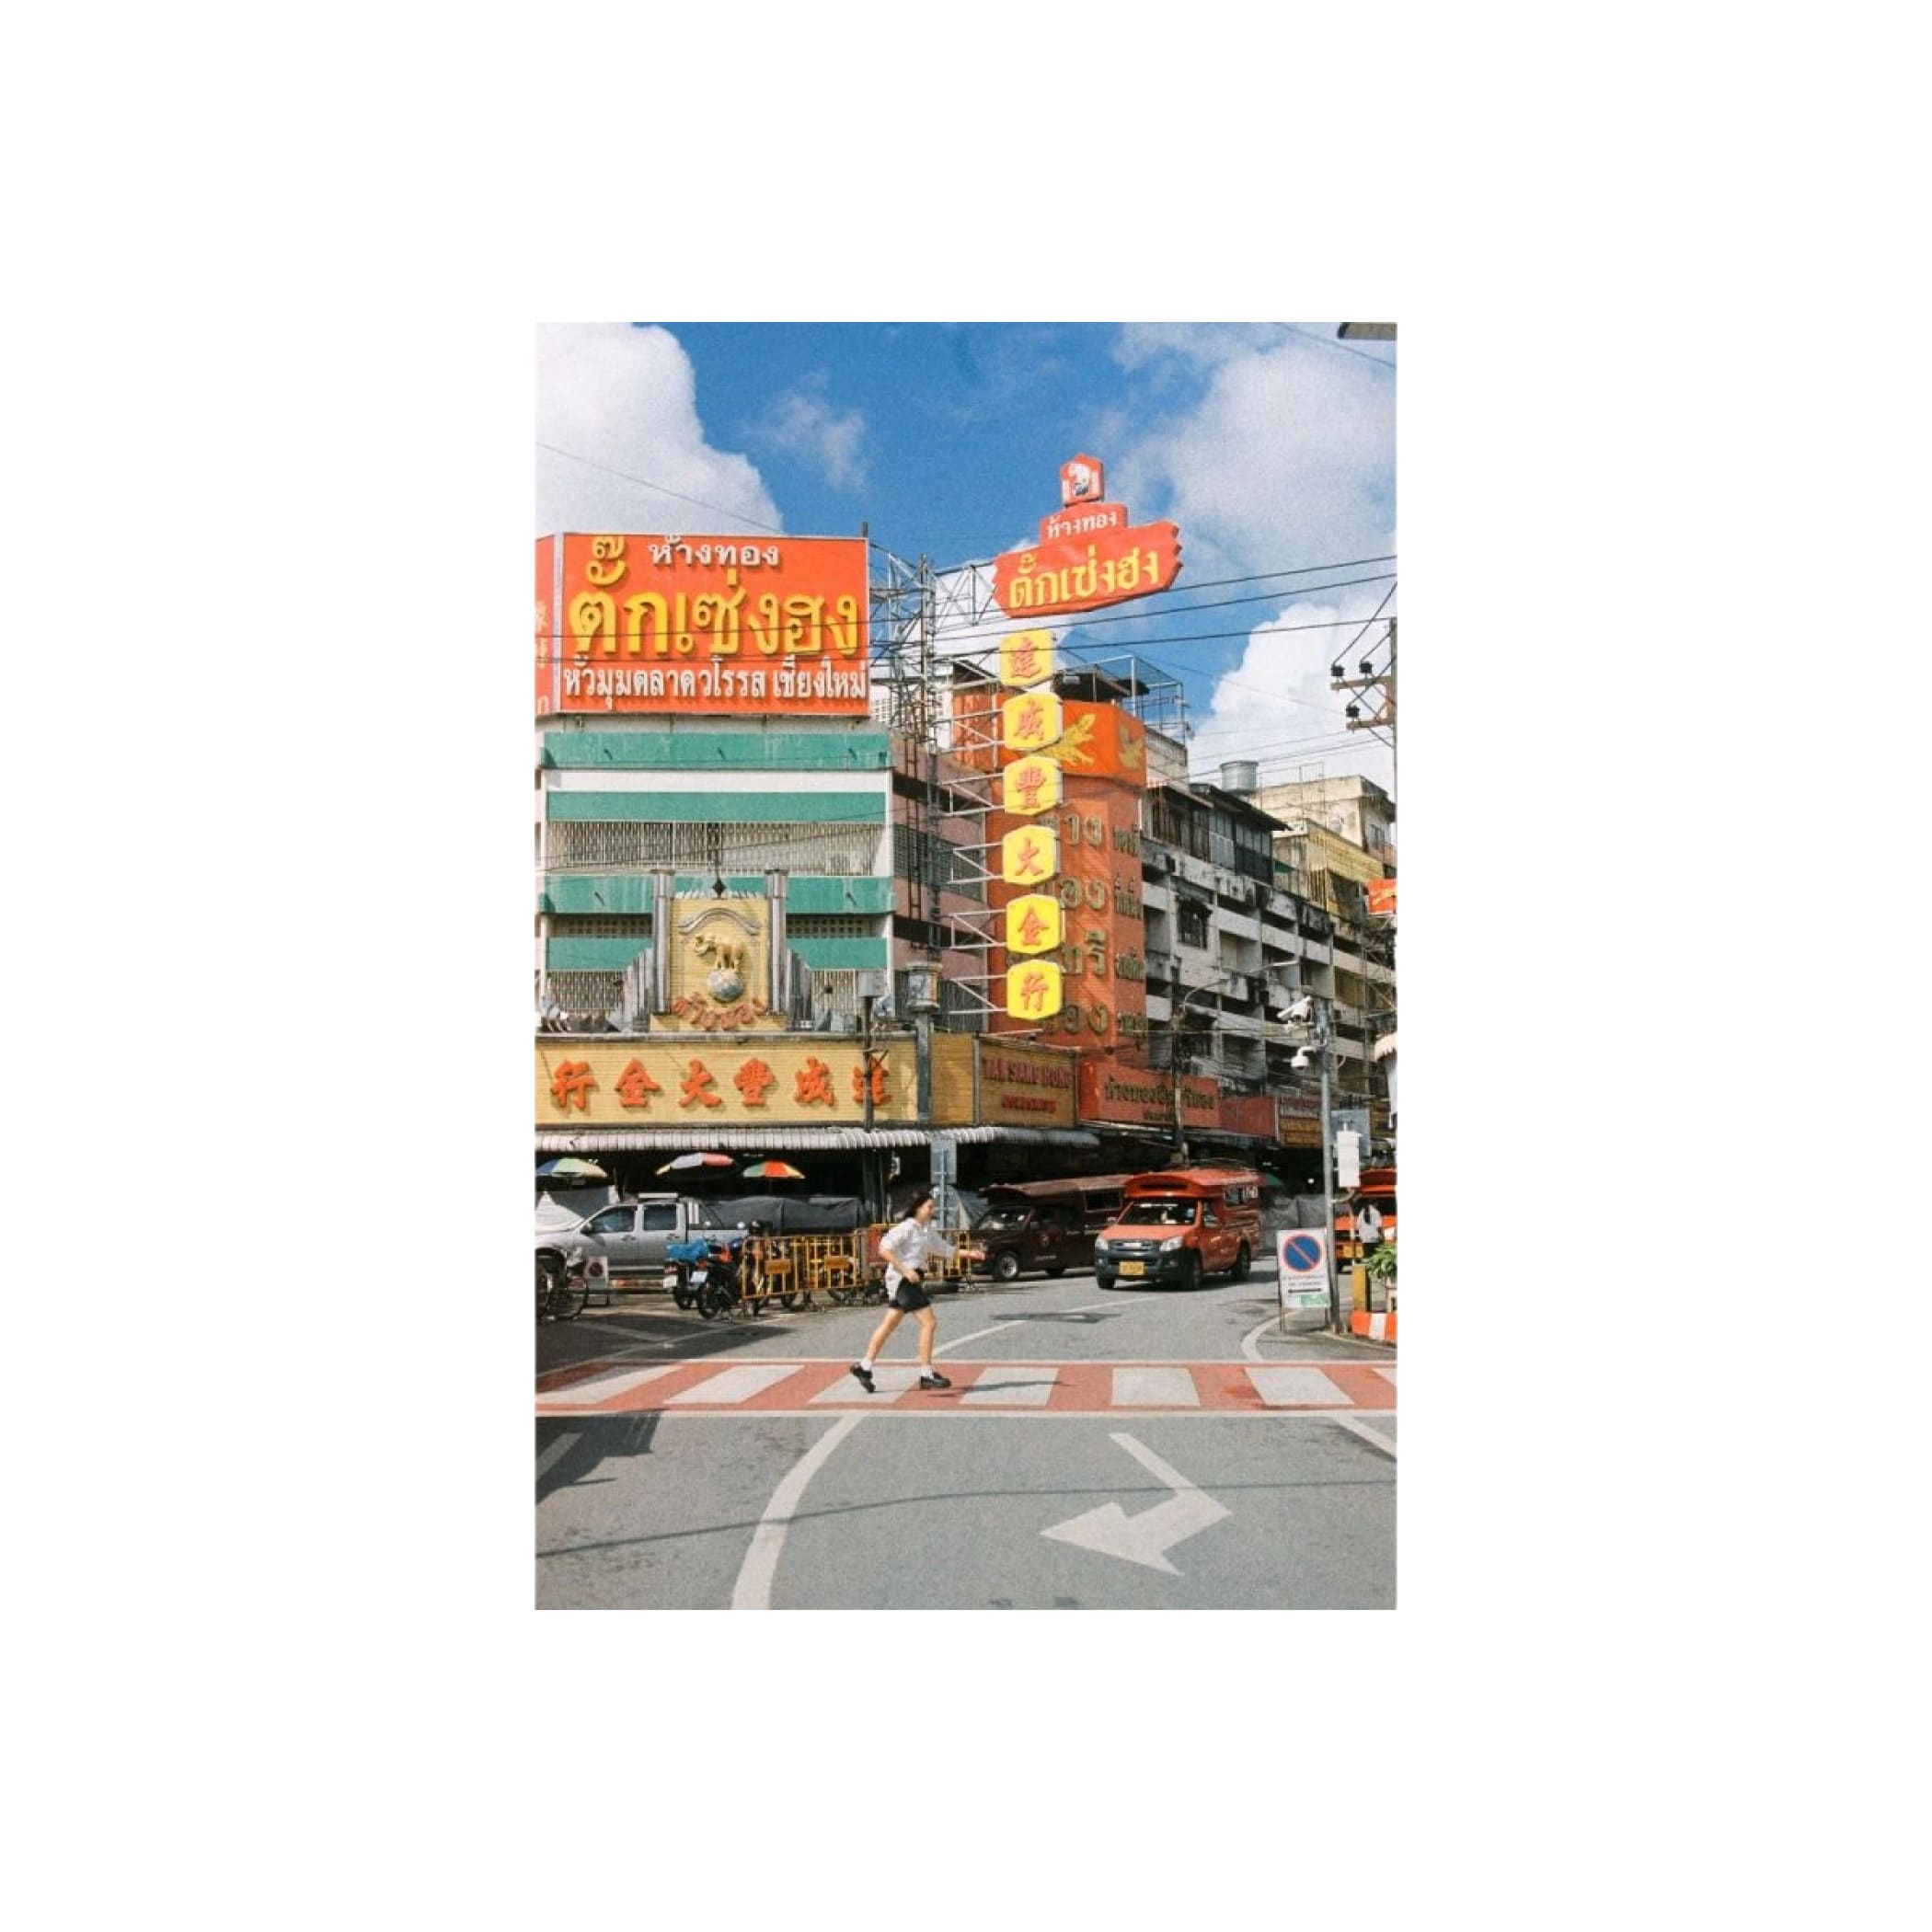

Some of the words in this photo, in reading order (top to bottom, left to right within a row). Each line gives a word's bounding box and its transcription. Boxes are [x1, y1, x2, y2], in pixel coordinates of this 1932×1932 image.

[1047, 511, 1118, 539] ห้างทอง
[649, 535, 780, 567] ห้างทอง
[569, 535, 859, 656] ตั๊กเซ่งฮง
[773, 654, 867, 699] เชียงใหม่
